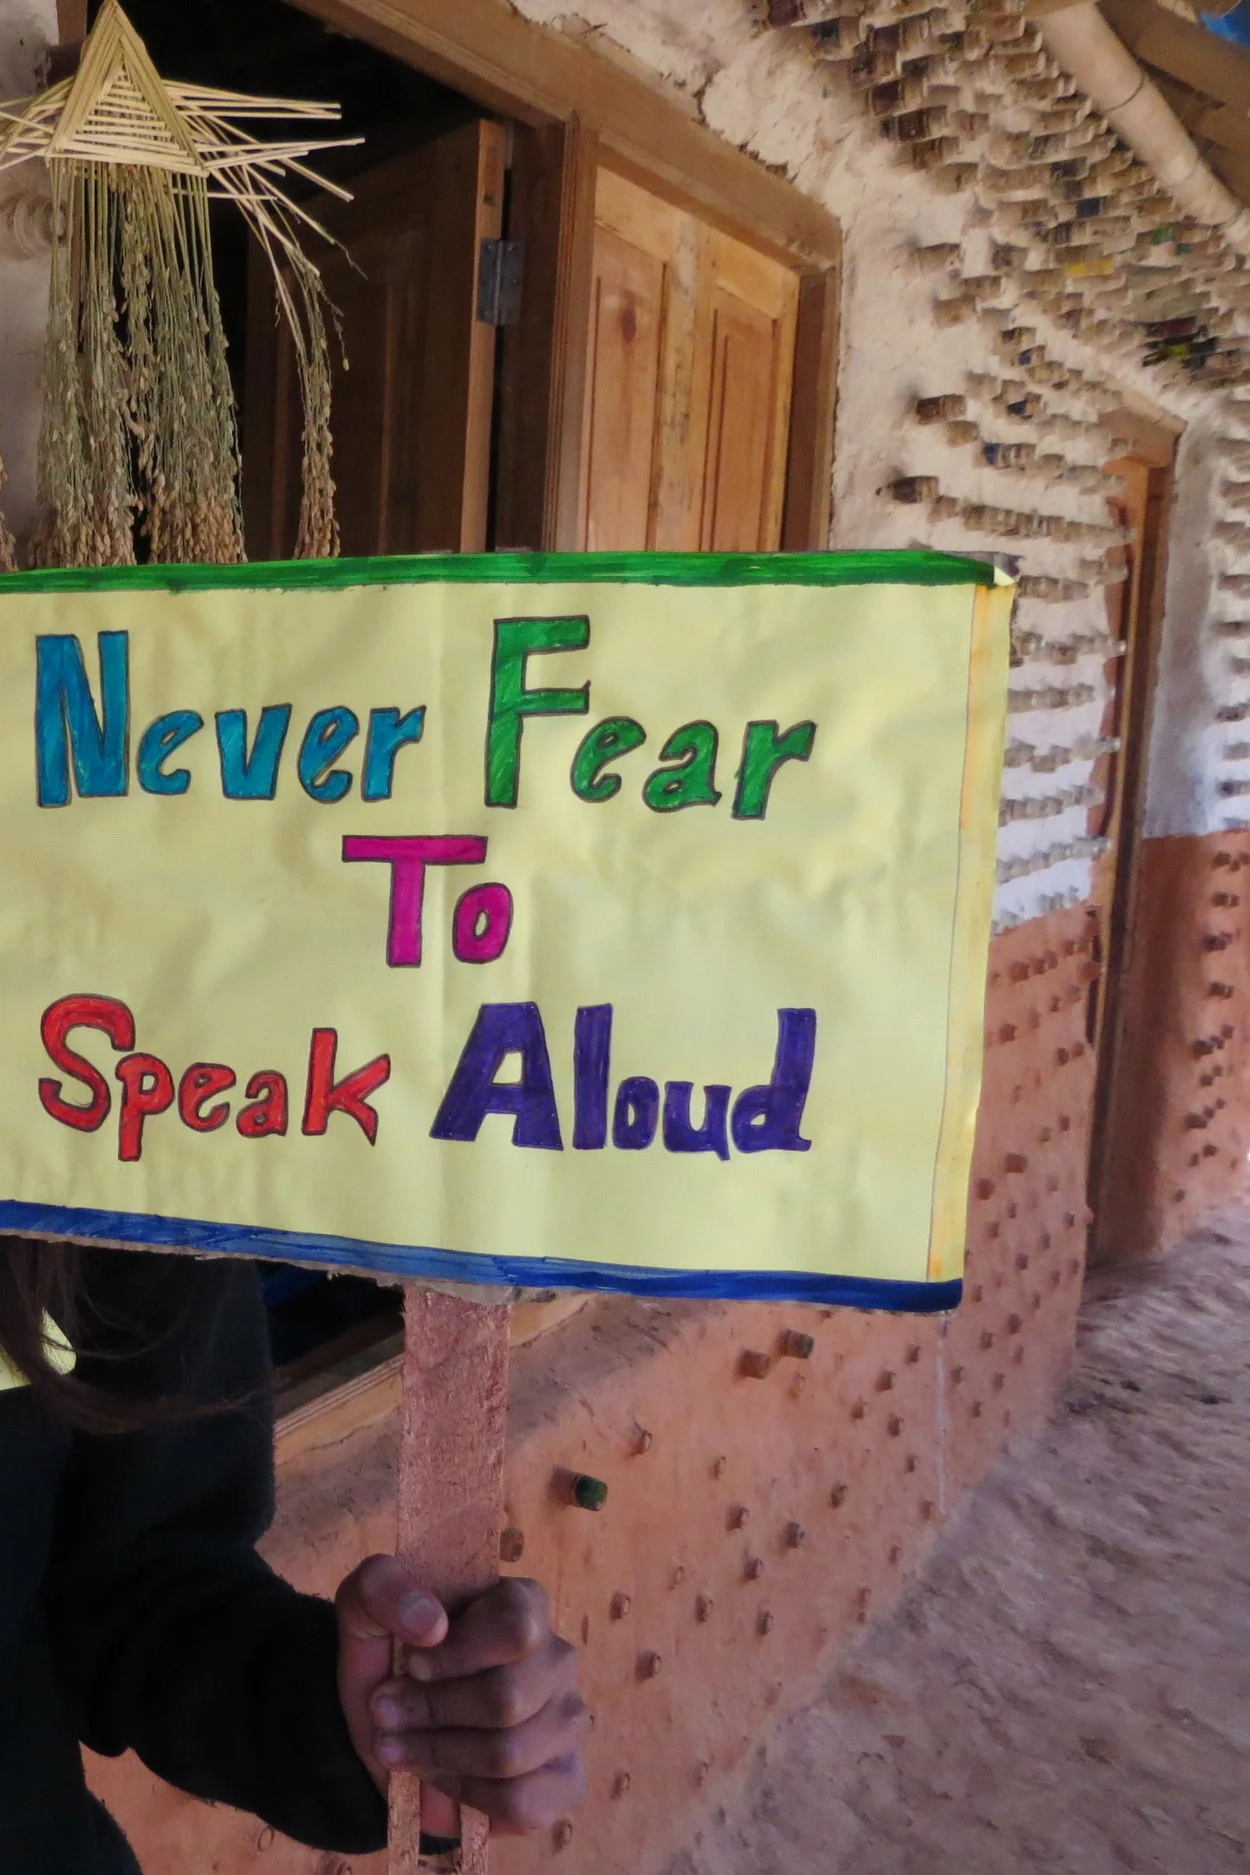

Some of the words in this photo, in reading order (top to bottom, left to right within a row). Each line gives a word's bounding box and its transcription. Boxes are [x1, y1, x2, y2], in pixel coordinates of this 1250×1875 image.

[34, 630, 426, 808] Never
[484, 614, 818, 821] Fear
[341, 834, 513, 968] To
[38, 994, 391, 1162] Speak
[429, 1001, 817, 1161] Aloud
